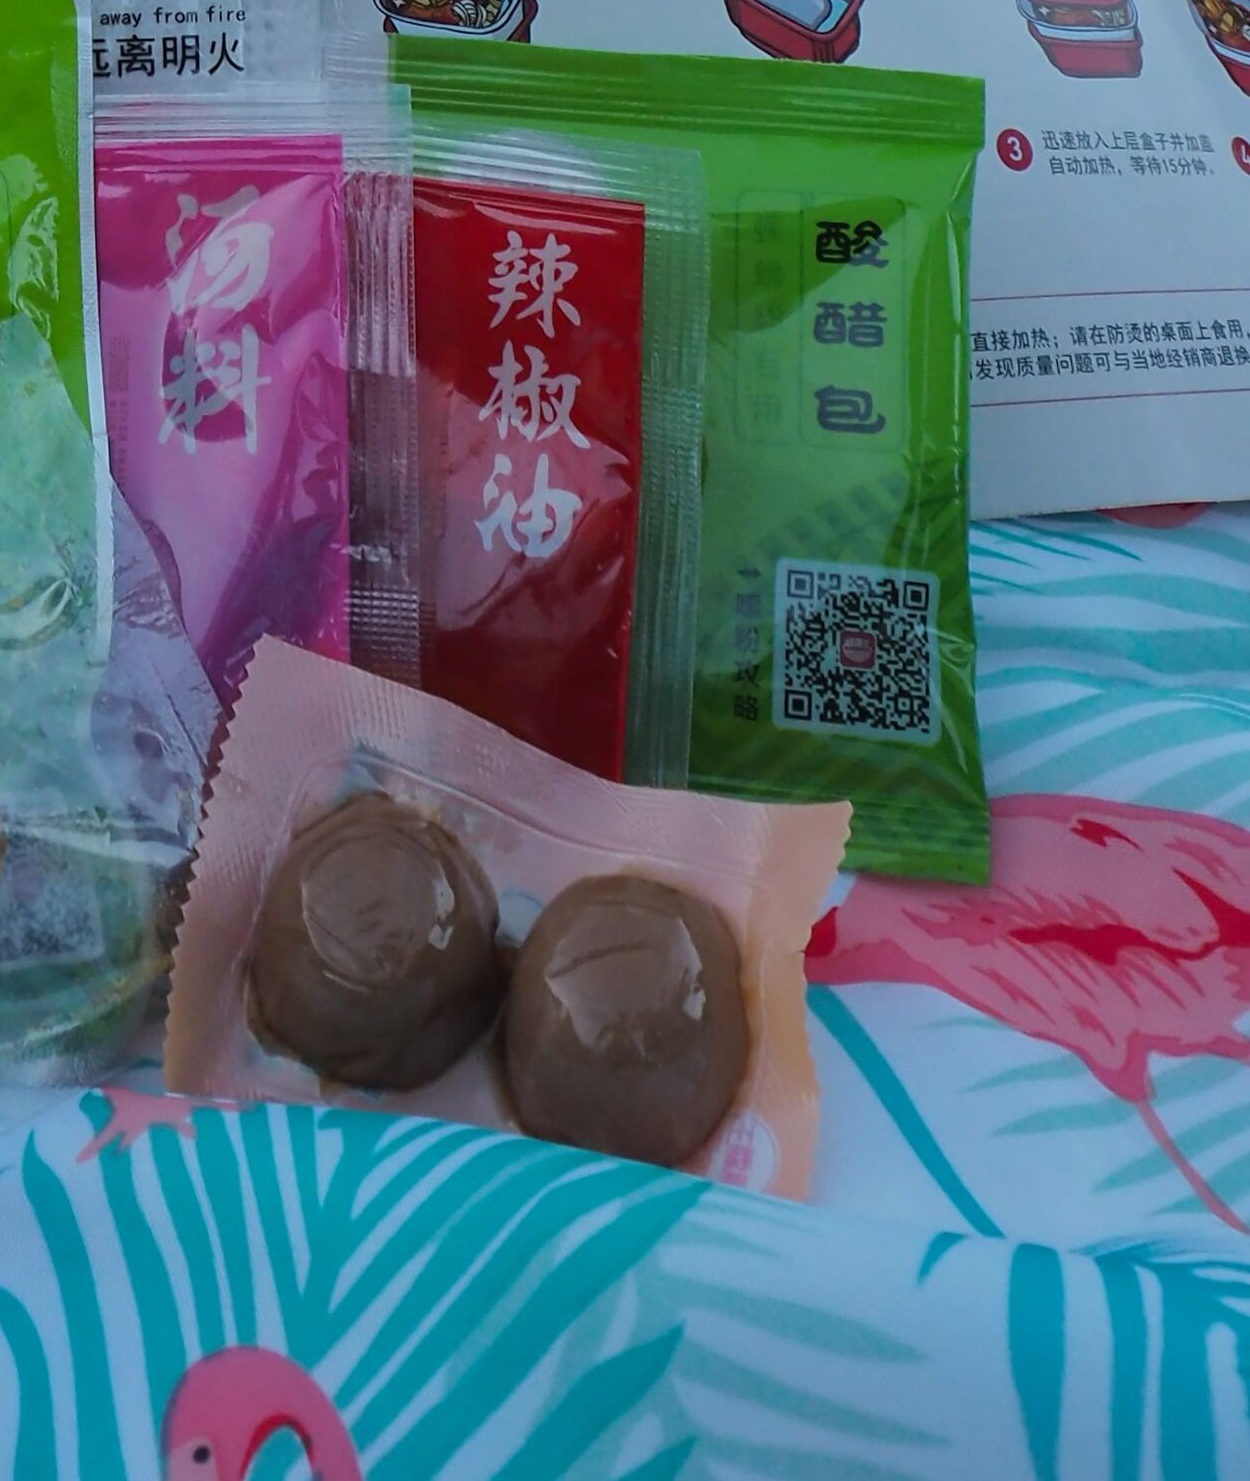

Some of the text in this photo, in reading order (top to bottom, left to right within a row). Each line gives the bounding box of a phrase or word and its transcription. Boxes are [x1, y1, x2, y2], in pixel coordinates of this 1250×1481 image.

[100, 5, 246, 28] away from fire
[473, 228, 591, 560] 辣椒油
[812, 219, 889, 434] 酸醋包
